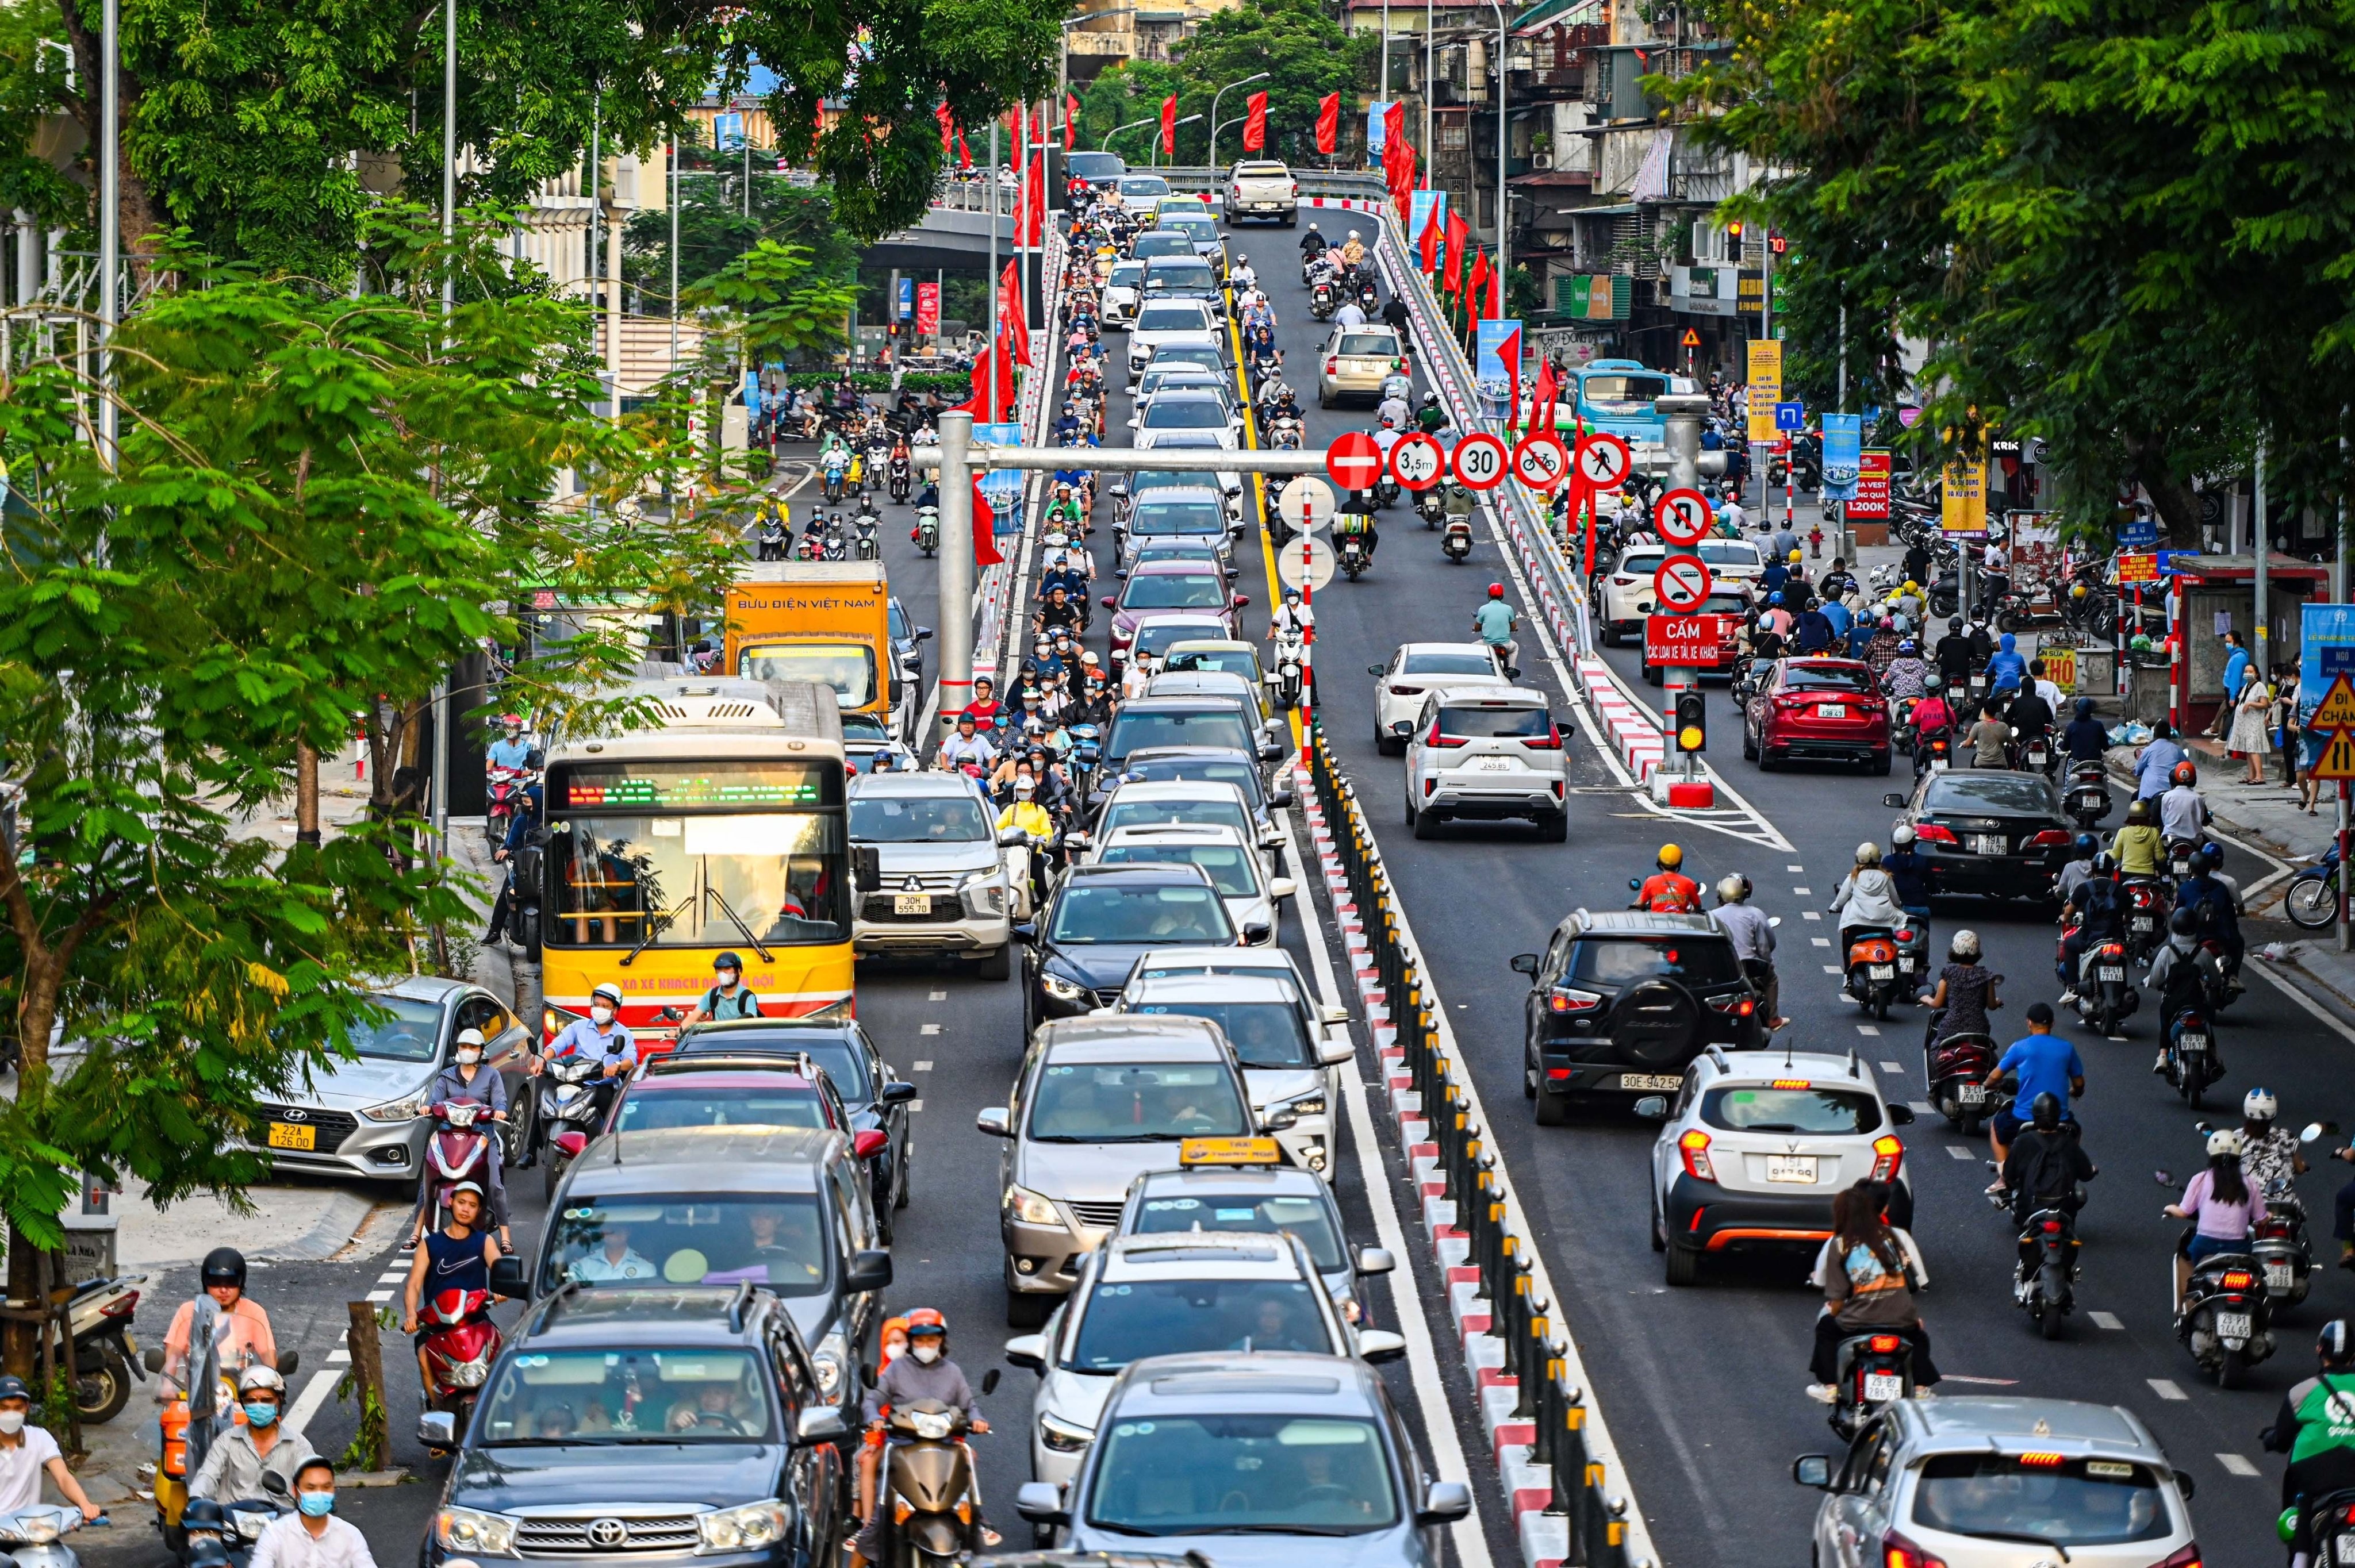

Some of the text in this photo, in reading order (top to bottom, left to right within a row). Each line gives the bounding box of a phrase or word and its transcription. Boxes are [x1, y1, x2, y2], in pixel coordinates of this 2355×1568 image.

[1769, 239, 1784, 252] 70
[1401, 452, 1432, 472] 3,5m
[1467, 450, 1493, 473] 30
[1870, 491, 1886, 499] QUÀ
[1848, 502, 1886, 511] 1.200K
[738, 597, 875, 611] BƯU ĐIỆN VIỆT NAM
[1666, 618, 1700, 639] CẤM
[1648, 641, 1718, 661] CÁC LOẠI XE TẢI, XE KHÁCH
[2335, 693, 2348, 705] ĐI
[1986, 836, 2000, 844] 29A
[898, 905, 927, 913] 555.70
[641, 978, 654, 989] XE
[1623, 1075, 1681, 1089] 30E-942.54
[283, 1125, 302, 1136] 22A
[276, 1136, 309, 1148] 126.00
